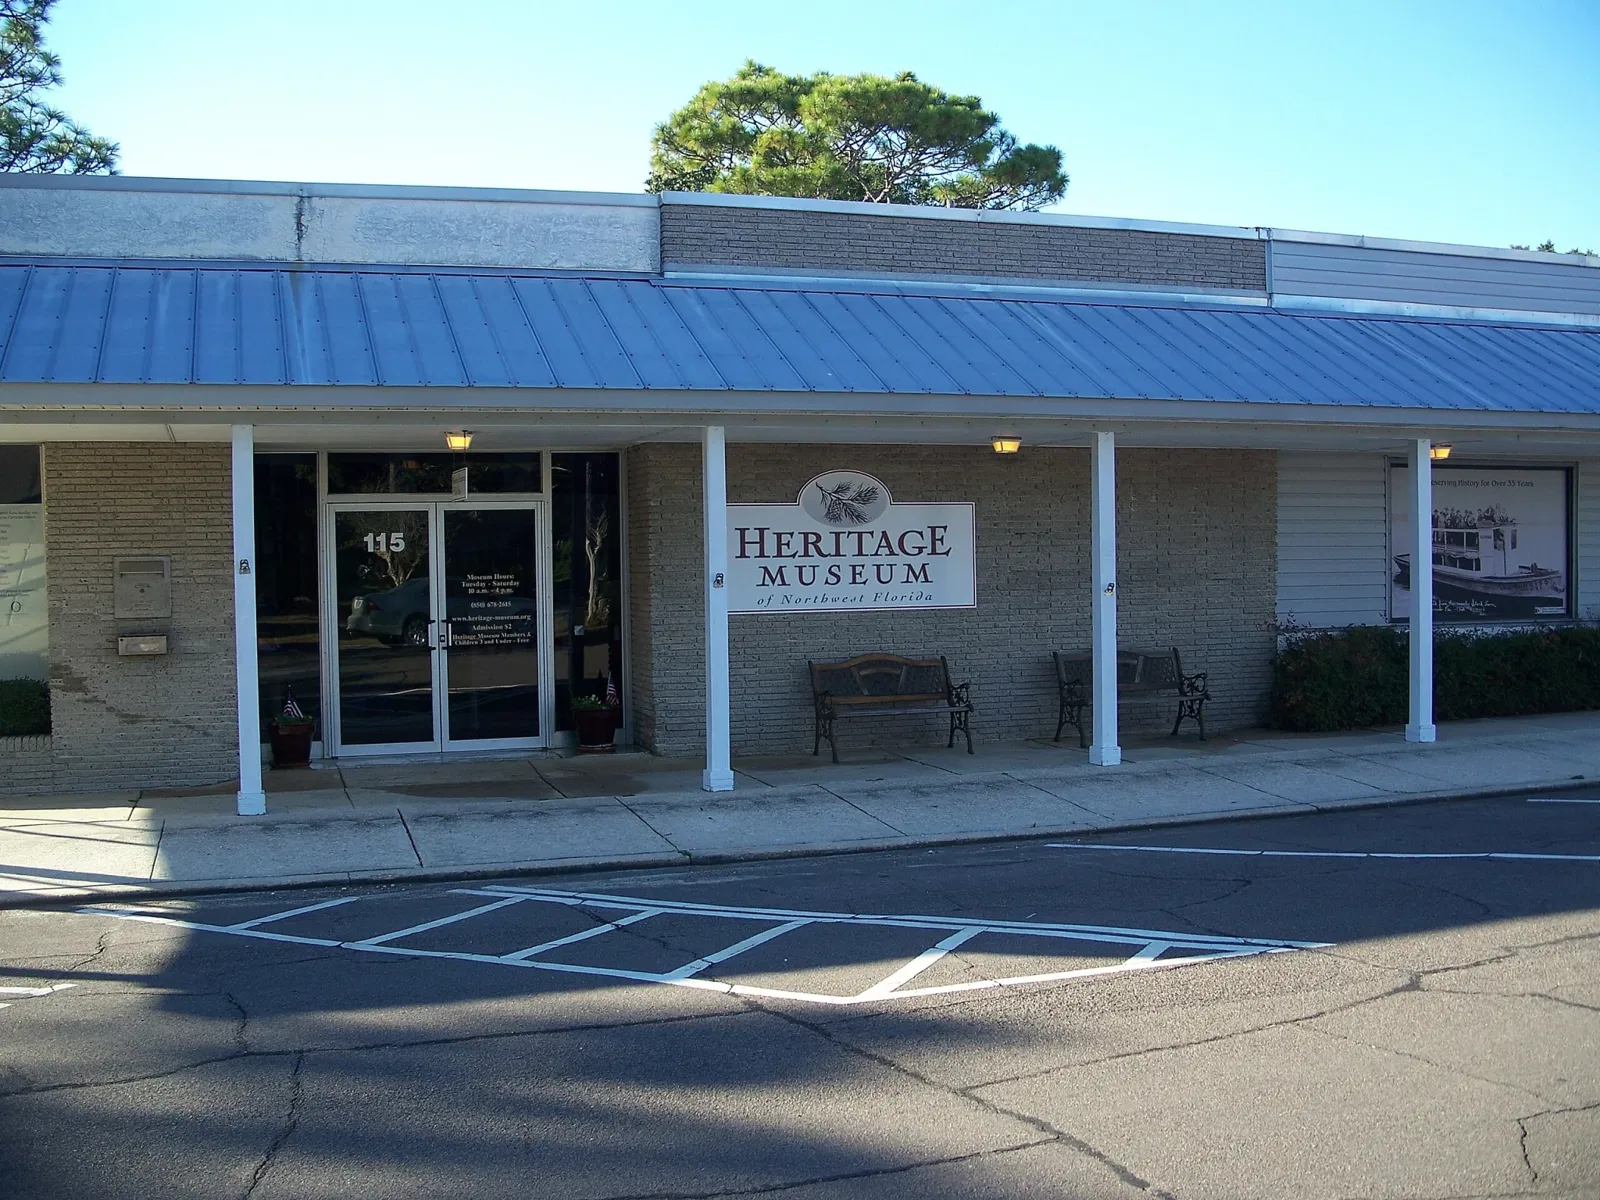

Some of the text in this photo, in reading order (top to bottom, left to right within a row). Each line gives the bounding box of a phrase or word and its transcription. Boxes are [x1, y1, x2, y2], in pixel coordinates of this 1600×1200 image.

[1431, 479, 1457, 488] eserving
[1458, 479, 1479, 488] History
[1481, 479, 1490, 487] for
[1491, 479, 1506, 487] Over
[1517, 479, 1534, 487] Years
[363, 532, 405, 553] 115
[734, 525, 952, 559] HERITAGE
[756, 562, 933, 587] MUSEUM
[757, 591, 933, 607] of Northwest Florida
